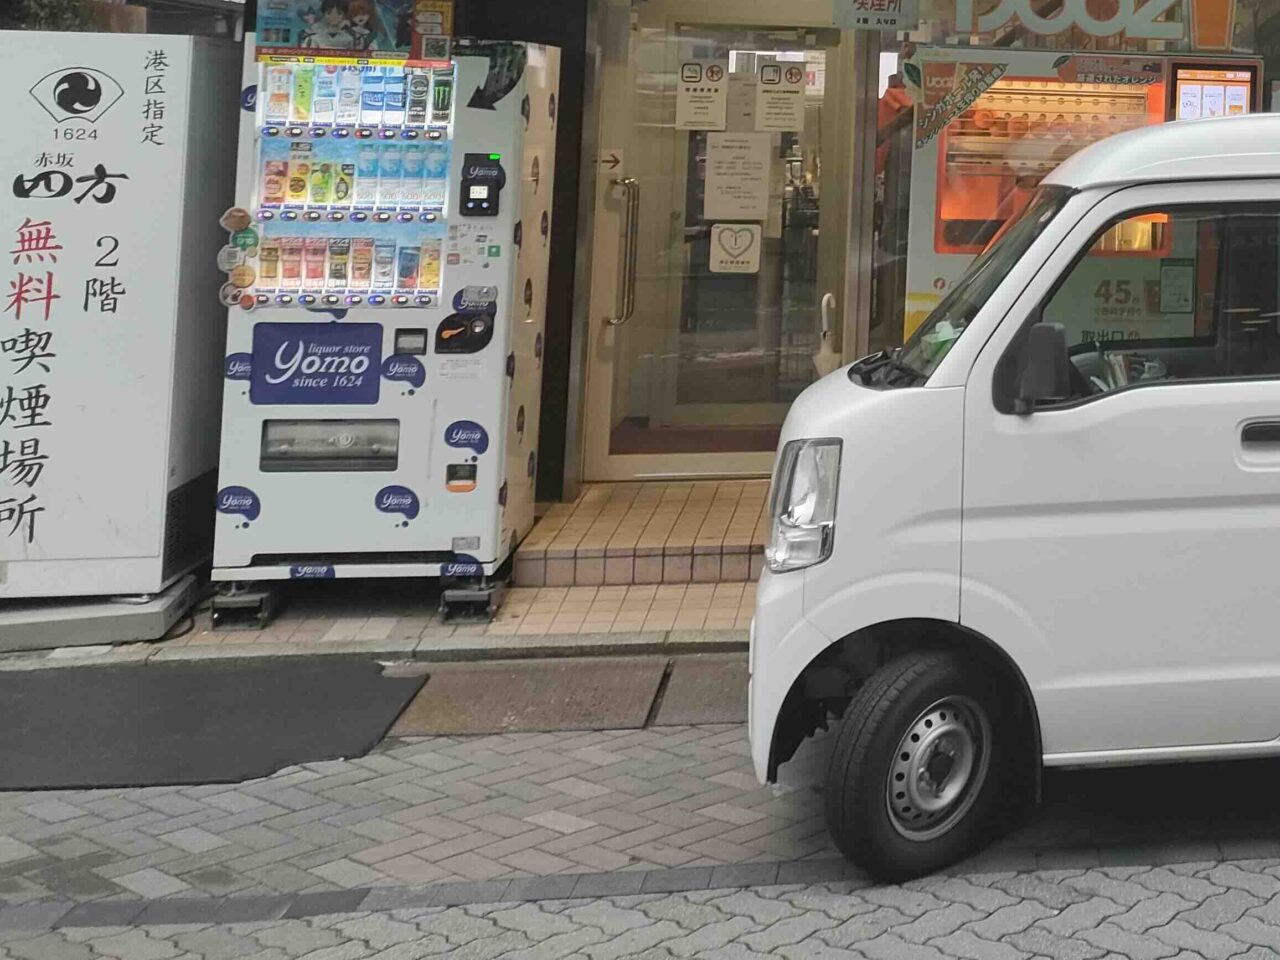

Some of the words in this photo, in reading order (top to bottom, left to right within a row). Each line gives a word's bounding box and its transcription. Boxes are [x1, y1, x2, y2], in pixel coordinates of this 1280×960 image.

[138, 49, 170, 146] 港区指定
[52, 128, 98, 141] 1624
[34, 151, 75, 168] 赤坂
[13, 163, 130, 204] 四方
[82, 235, 127, 314] 2階
[307, 343, 340, 356] liquor
[343, 344, 371, 354] store
[292, 375, 328, 388] since
[332, 376, 364, 388] 1624
